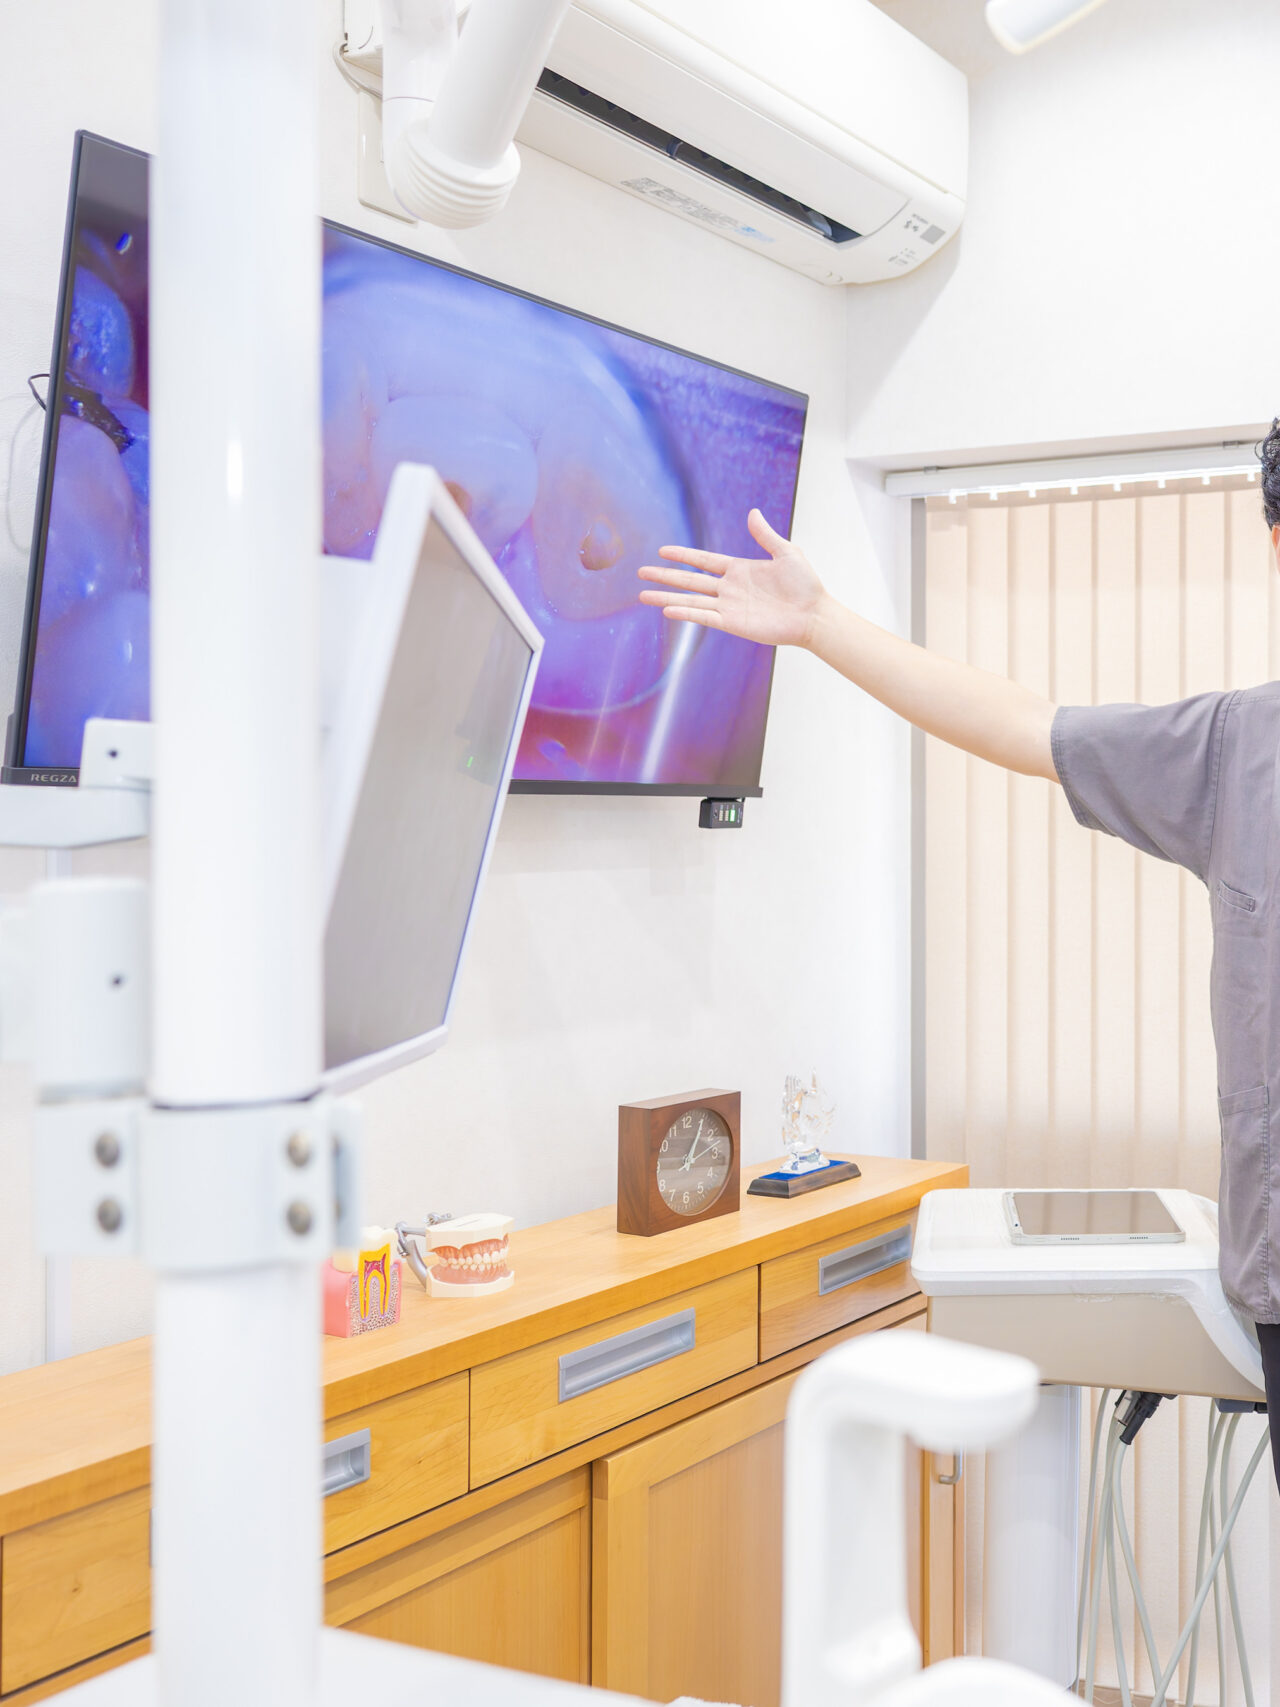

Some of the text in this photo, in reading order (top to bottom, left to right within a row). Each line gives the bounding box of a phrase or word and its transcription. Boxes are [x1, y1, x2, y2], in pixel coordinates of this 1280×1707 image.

[31, 773, 77, 783] REGZA
[682, 1115, 692, 1129] 12
[707, 1129, 714, 1142] 2
[711, 1147, 718, 1159] 3
[707, 1166, 713, 1178] 4
[658, 1179, 666, 1192] 8
[697, 1182, 704, 1194] 5
[669, 1189, 676, 1202] 7
[683, 1191, 690, 1204] 6
